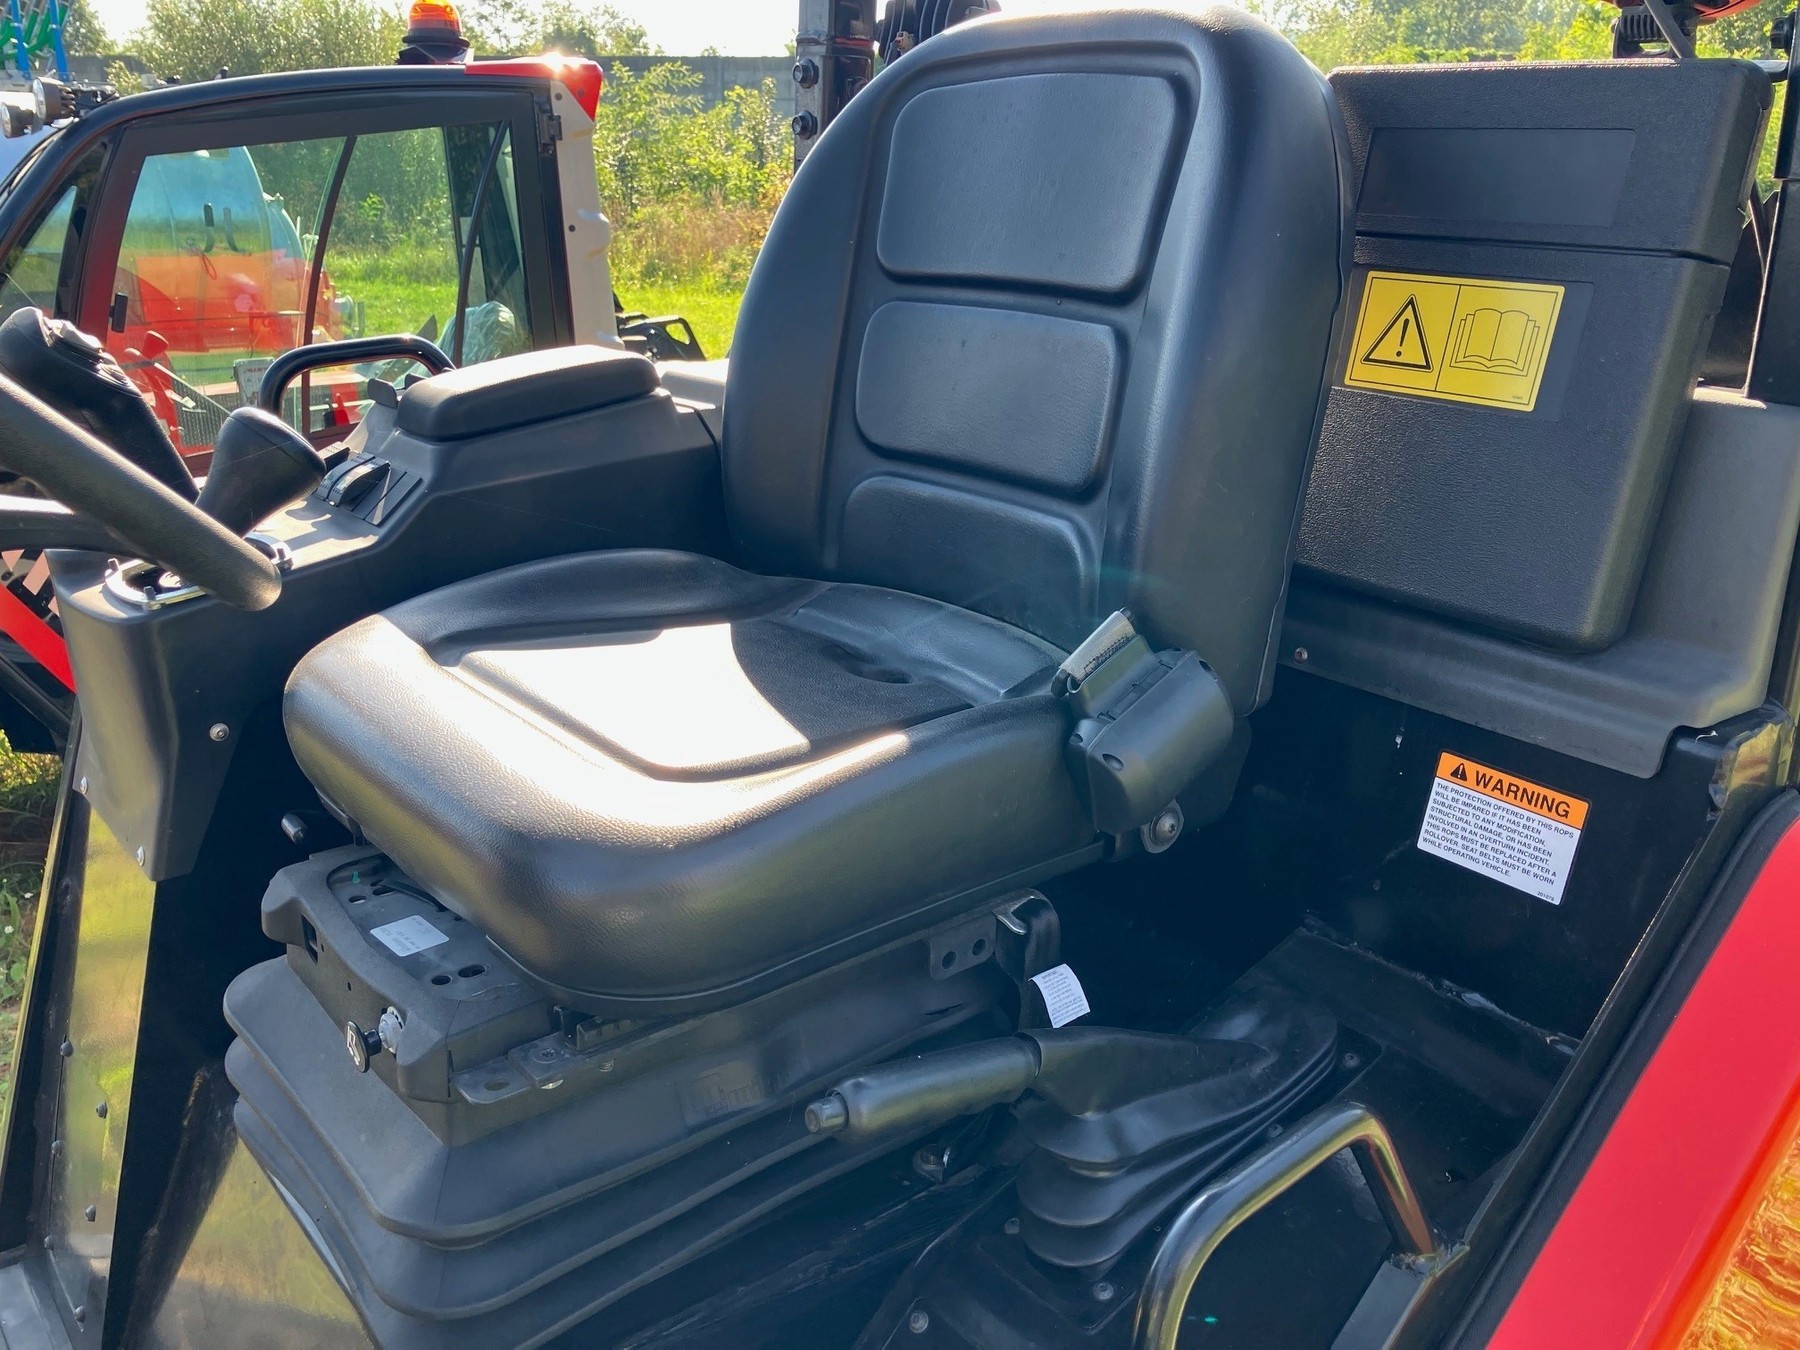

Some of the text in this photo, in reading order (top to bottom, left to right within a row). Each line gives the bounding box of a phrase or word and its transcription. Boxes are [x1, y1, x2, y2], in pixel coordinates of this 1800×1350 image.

[1434, 790, 1450, 801] WILL
[1450, 796, 1461, 805] BE
[1460, 800, 1491, 816] IMPARED
[1498, 814, 1506, 822] IT
[1506, 817, 1521, 828] HAS
[1521, 823, 1542, 836] BEEN
[1437, 782, 1574, 839] THE PROTECTION OFFERED BY THIS ROPS
[1475, 771, 1570, 818] WARNING
[1426, 820, 1441, 831] THIS
[1441, 826, 1460, 839] ROPS
[1460, 834, 1479, 846] MUST
[1479, 842, 1490, 851] BE
[1490, 846, 1527, 865] REPLACED
[1527, 861, 1551, 875] AFTER
[1428, 813, 1550, 866] INVOLVED IN AN OVERTURN INCIDENT.
[1430, 805, 1553, 858] STRUCTURAL DAMAGE, OR HAS BEEN
[1432, 798, 1546, 847] SUBJECTED TO ANY MODIFICATION,
[1422, 836, 1510, 876] WHILE OPERATING VEHICLE.
[1424, 828, 1555, 886] ROLLOVER. SEAT BELTS MUST BE WORN
